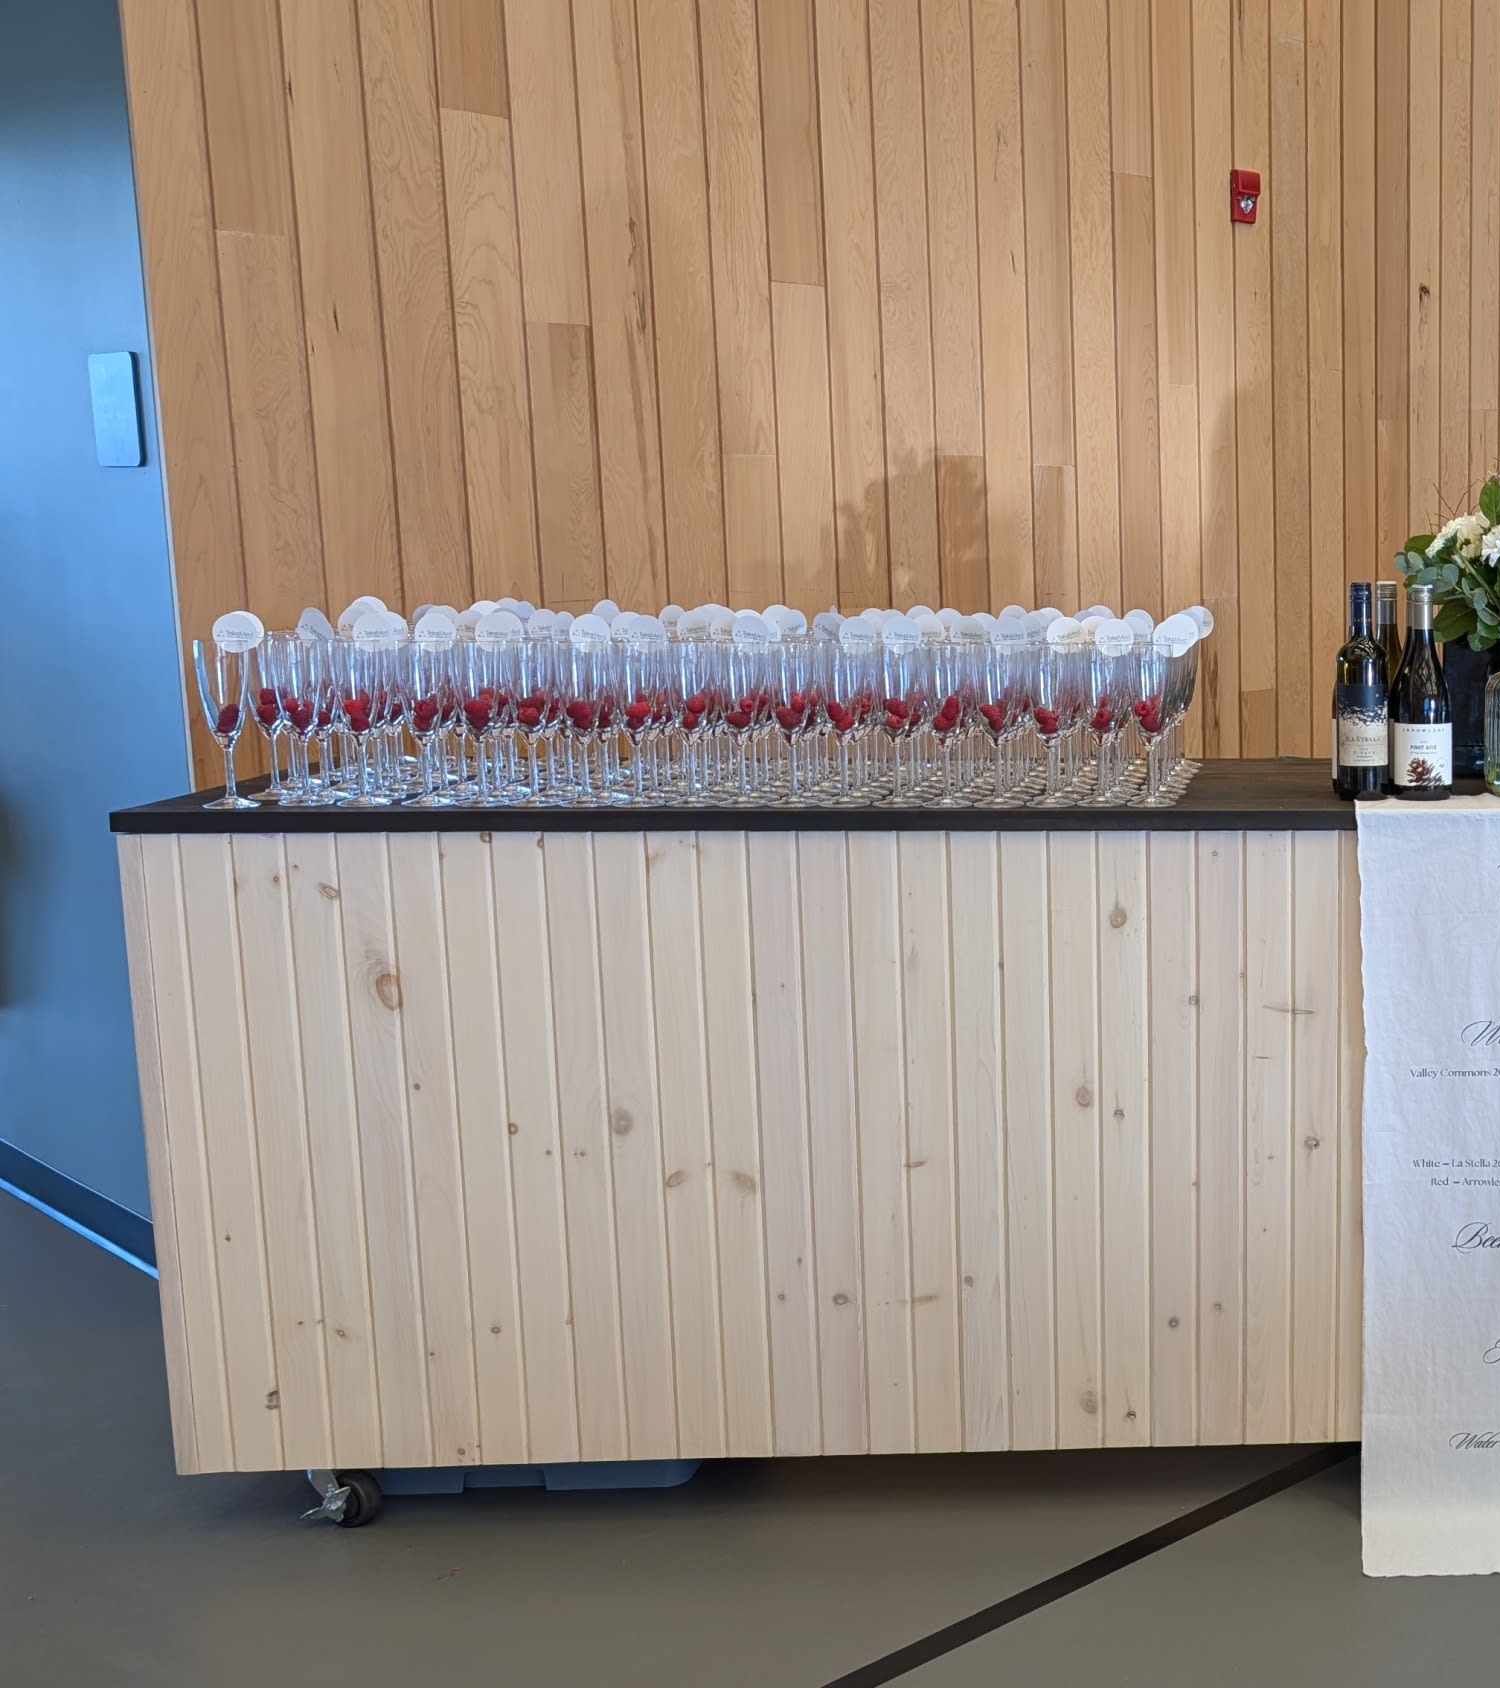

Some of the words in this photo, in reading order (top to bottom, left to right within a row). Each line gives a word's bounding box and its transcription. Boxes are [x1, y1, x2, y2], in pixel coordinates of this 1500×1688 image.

[1410, 1068, 1438, 1078] Valley
[1440, 1068, 1491, 1077] Commons
[1413, 1159, 1440, 1167] White
[1465, 1159, 1490, 1167] Stella
[1431, 1177, 1448, 1186] Red
